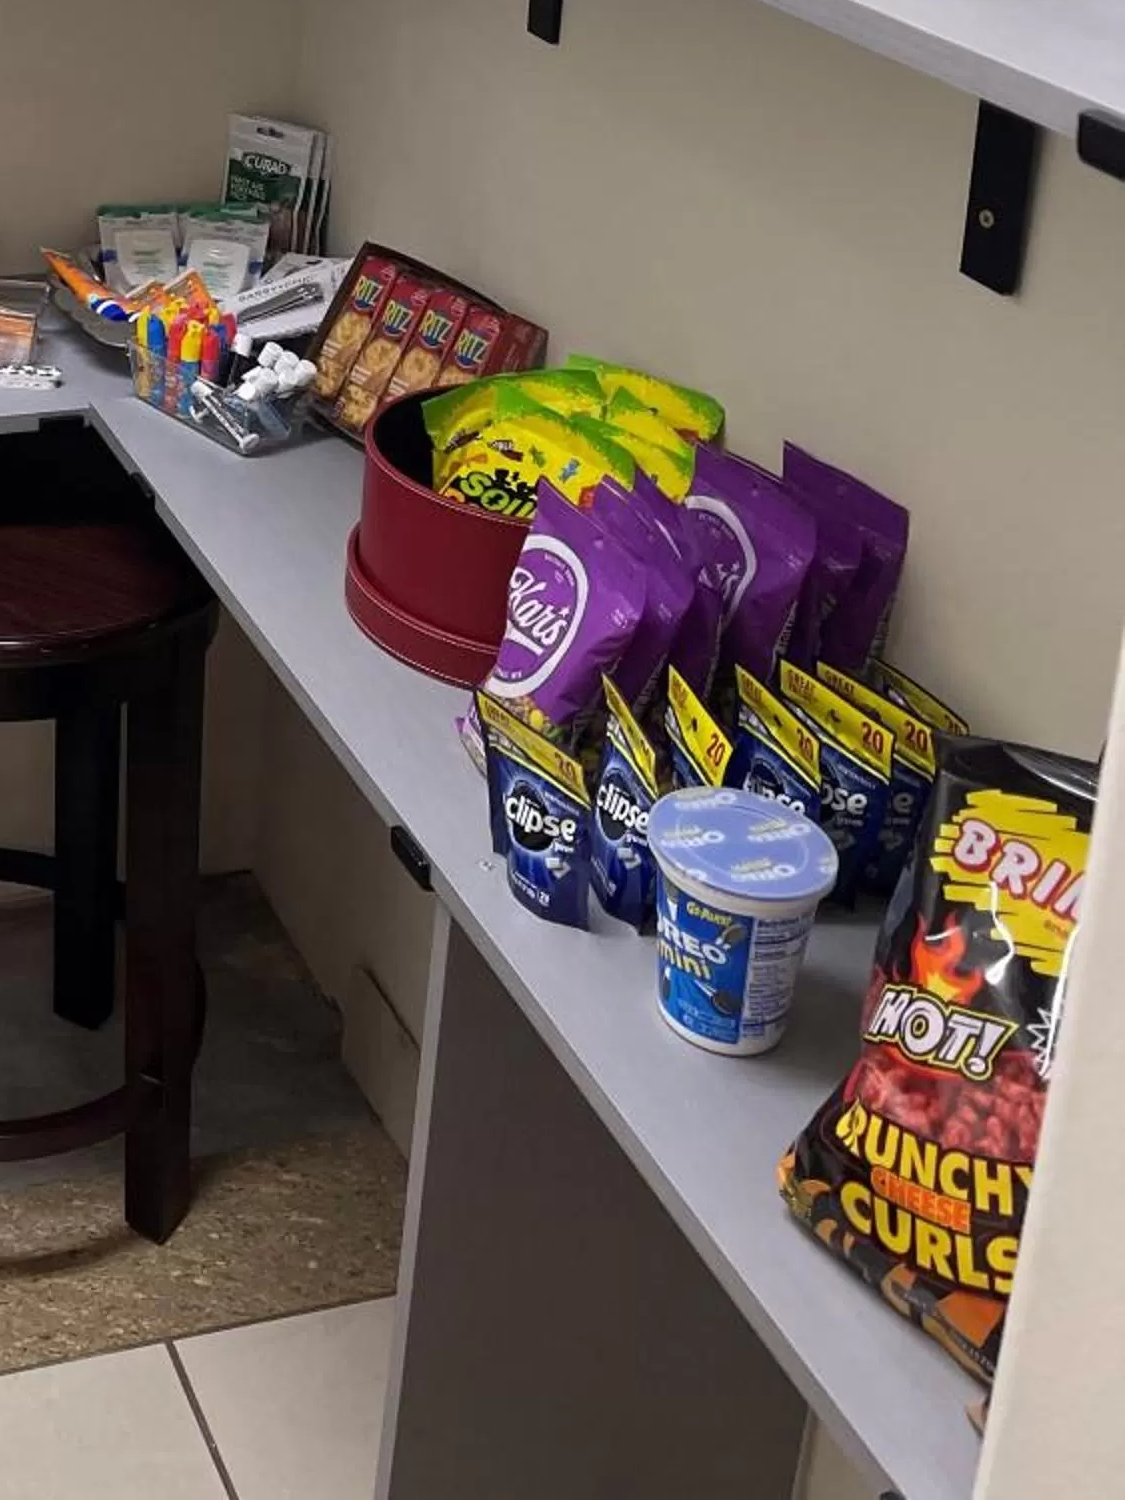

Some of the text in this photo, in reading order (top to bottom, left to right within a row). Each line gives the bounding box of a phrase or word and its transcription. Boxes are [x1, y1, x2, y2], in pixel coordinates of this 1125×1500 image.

[244, 153, 289, 176] CURAD
[352, 275, 383, 306] RITZ
[382, 300, 414, 332] RITZ
[419, 310, 454, 344] RITZ
[455, 329, 490, 363] RITZ
[509, 566, 571, 646] Kar's
[706, 731, 726, 768] 20
[860, 721, 885, 755] 20
[904, 720, 929, 752] 20
[866, 986, 1013, 1077] HOT!
[870, 1167, 971, 1234] CHEESE
[840, 1180, 1020, 1295] CURLS
